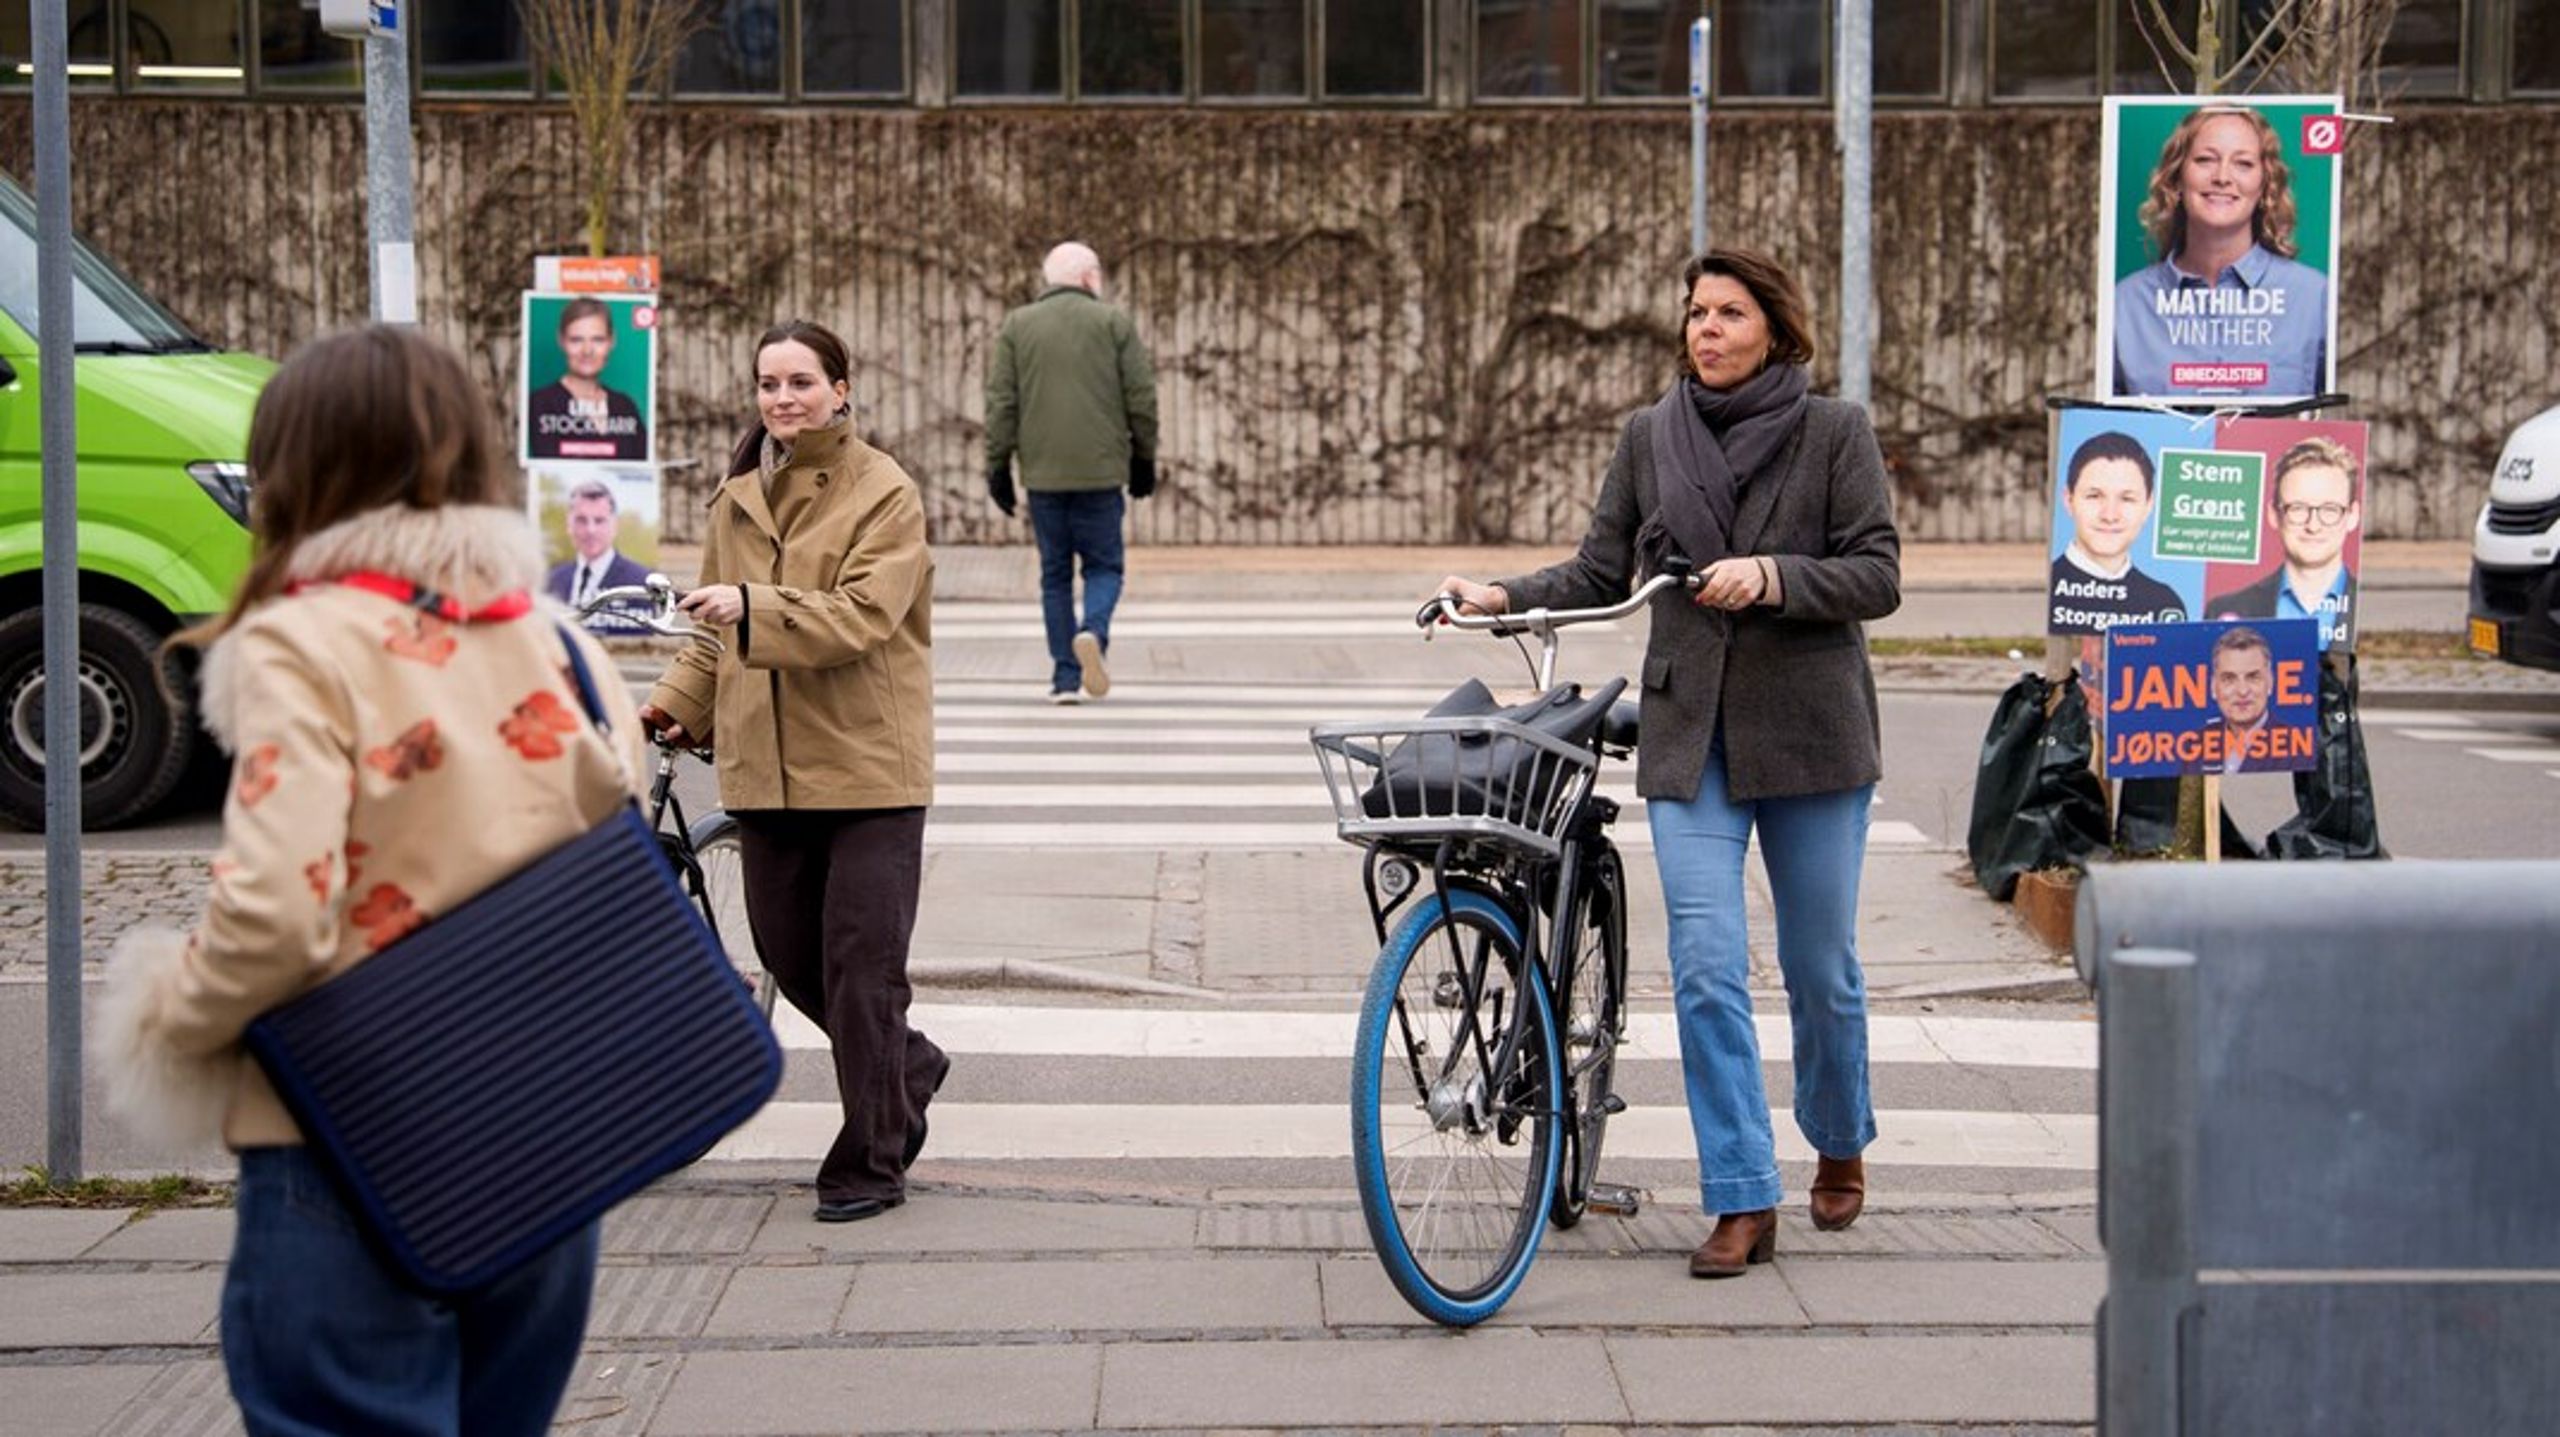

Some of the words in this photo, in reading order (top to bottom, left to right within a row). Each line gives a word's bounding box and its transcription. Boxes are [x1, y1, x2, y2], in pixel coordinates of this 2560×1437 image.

[2156, 288, 2285, 315] MATHILDE
[2166, 318, 2272, 345] VINTHER
[2179, 460, 2243, 484] Stem
[2173, 493, 2246, 520] Grønt
[2055, 579, 2128, 599] Anders
[2053, 607, 2154, 630] Storgaard
[2110, 664, 2207, 711] JAN
[2277, 661, 2314, 705] E.
[2110, 727, 2313, 764] JØRGENSEN
